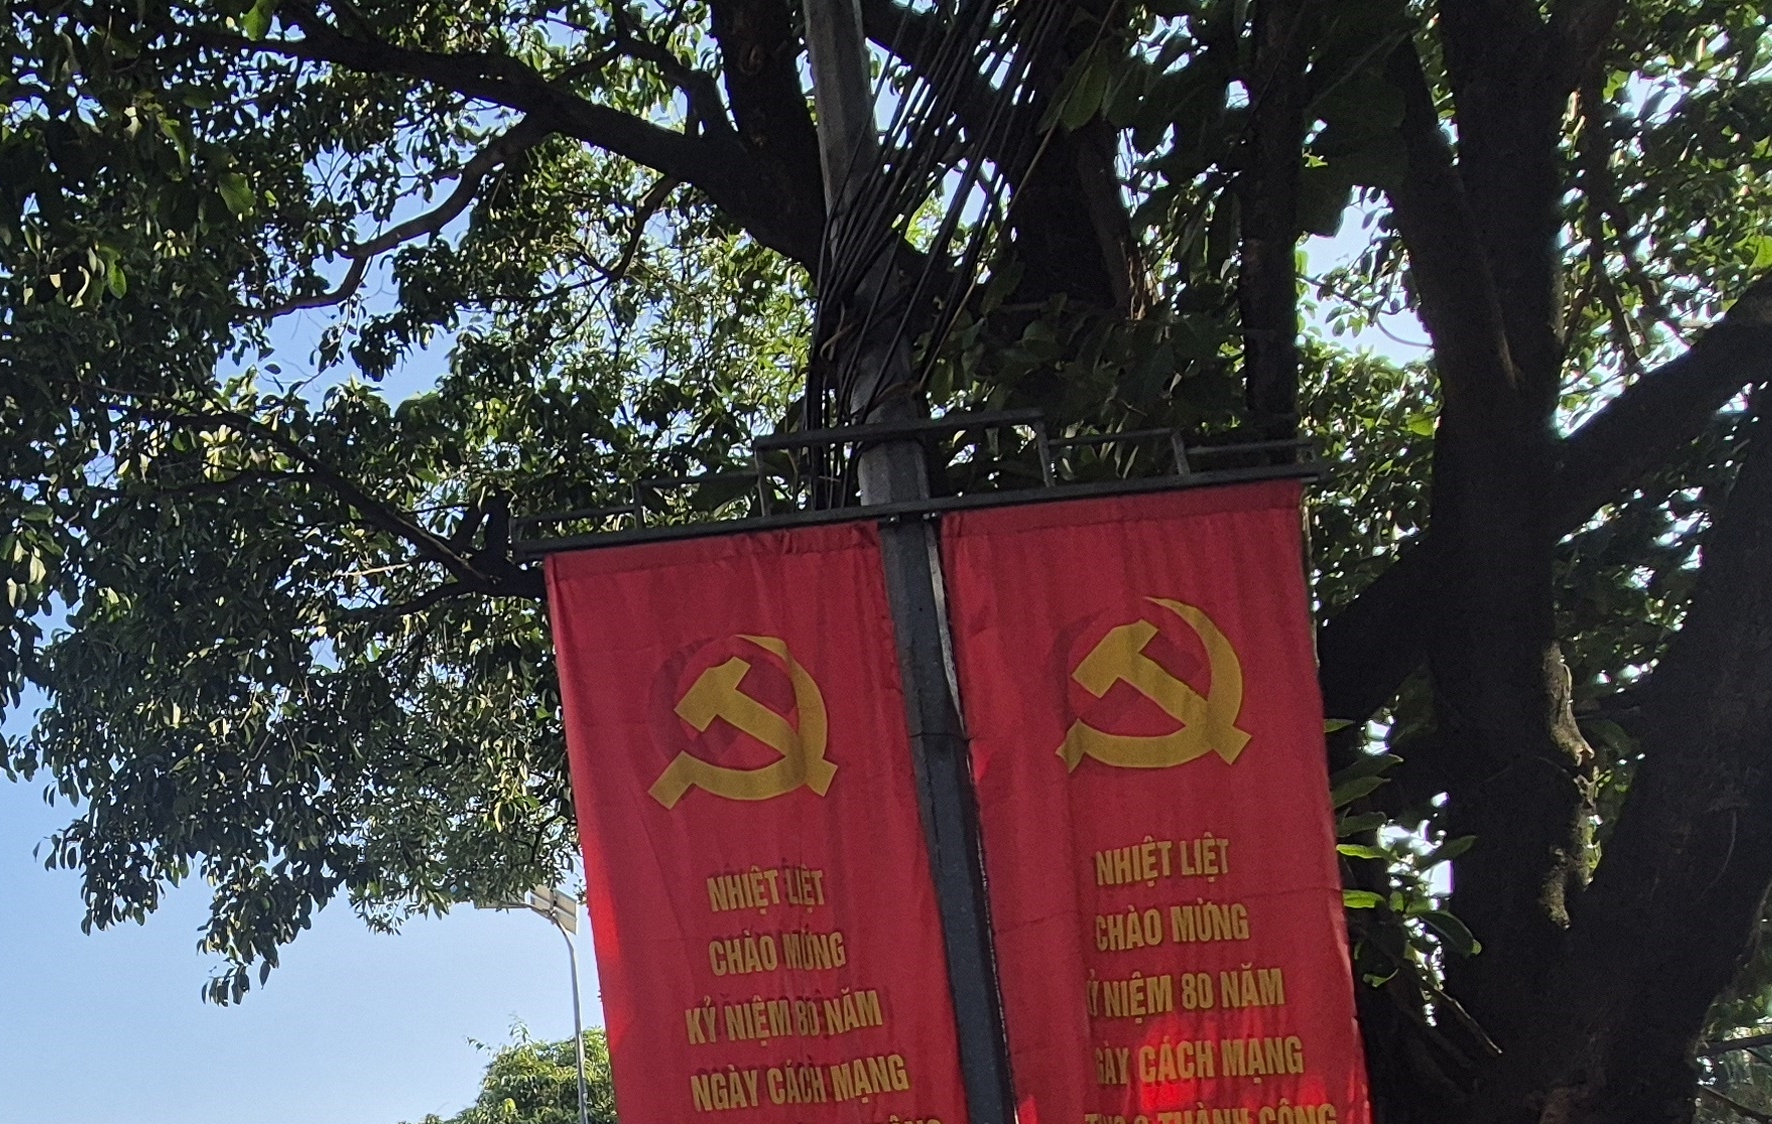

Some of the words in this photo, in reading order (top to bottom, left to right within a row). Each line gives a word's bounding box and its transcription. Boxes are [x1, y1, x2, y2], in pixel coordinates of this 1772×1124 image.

[1096, 835, 1172, 887] NHIỆT
[1179, 832, 1229, 883] LIỆT
[707, 865, 780, 915] NHIỆT
[784, 863, 824, 914] LIỆT
[1095, 905, 1163, 952] CHÀO
[1170, 898, 1249, 943] MỪNG
[708, 929, 778, 976] CHÀO
[685, 996, 716, 1044] KỶ
[725, 995, 792, 1046] NIỆM
[796, 1000, 820, 1036] 80
[822, 988, 883, 1036] NĂM
[1103, 972, 1172, 1024] NIỆM
[1181, 972, 1214, 1010] 80
[1221, 963, 1285, 1007] NĂM
[691, 1064, 758, 1111] NGÀY
[767, 1059, 826, 1104] CÁCH
[829, 1054, 909, 1103] MẠNG
[1095, 1040, 1129, 1085] GÀY
[1139, 1036, 1214, 1082] CÁCH
[1222, 1036, 1304, 1083] MẠNG
